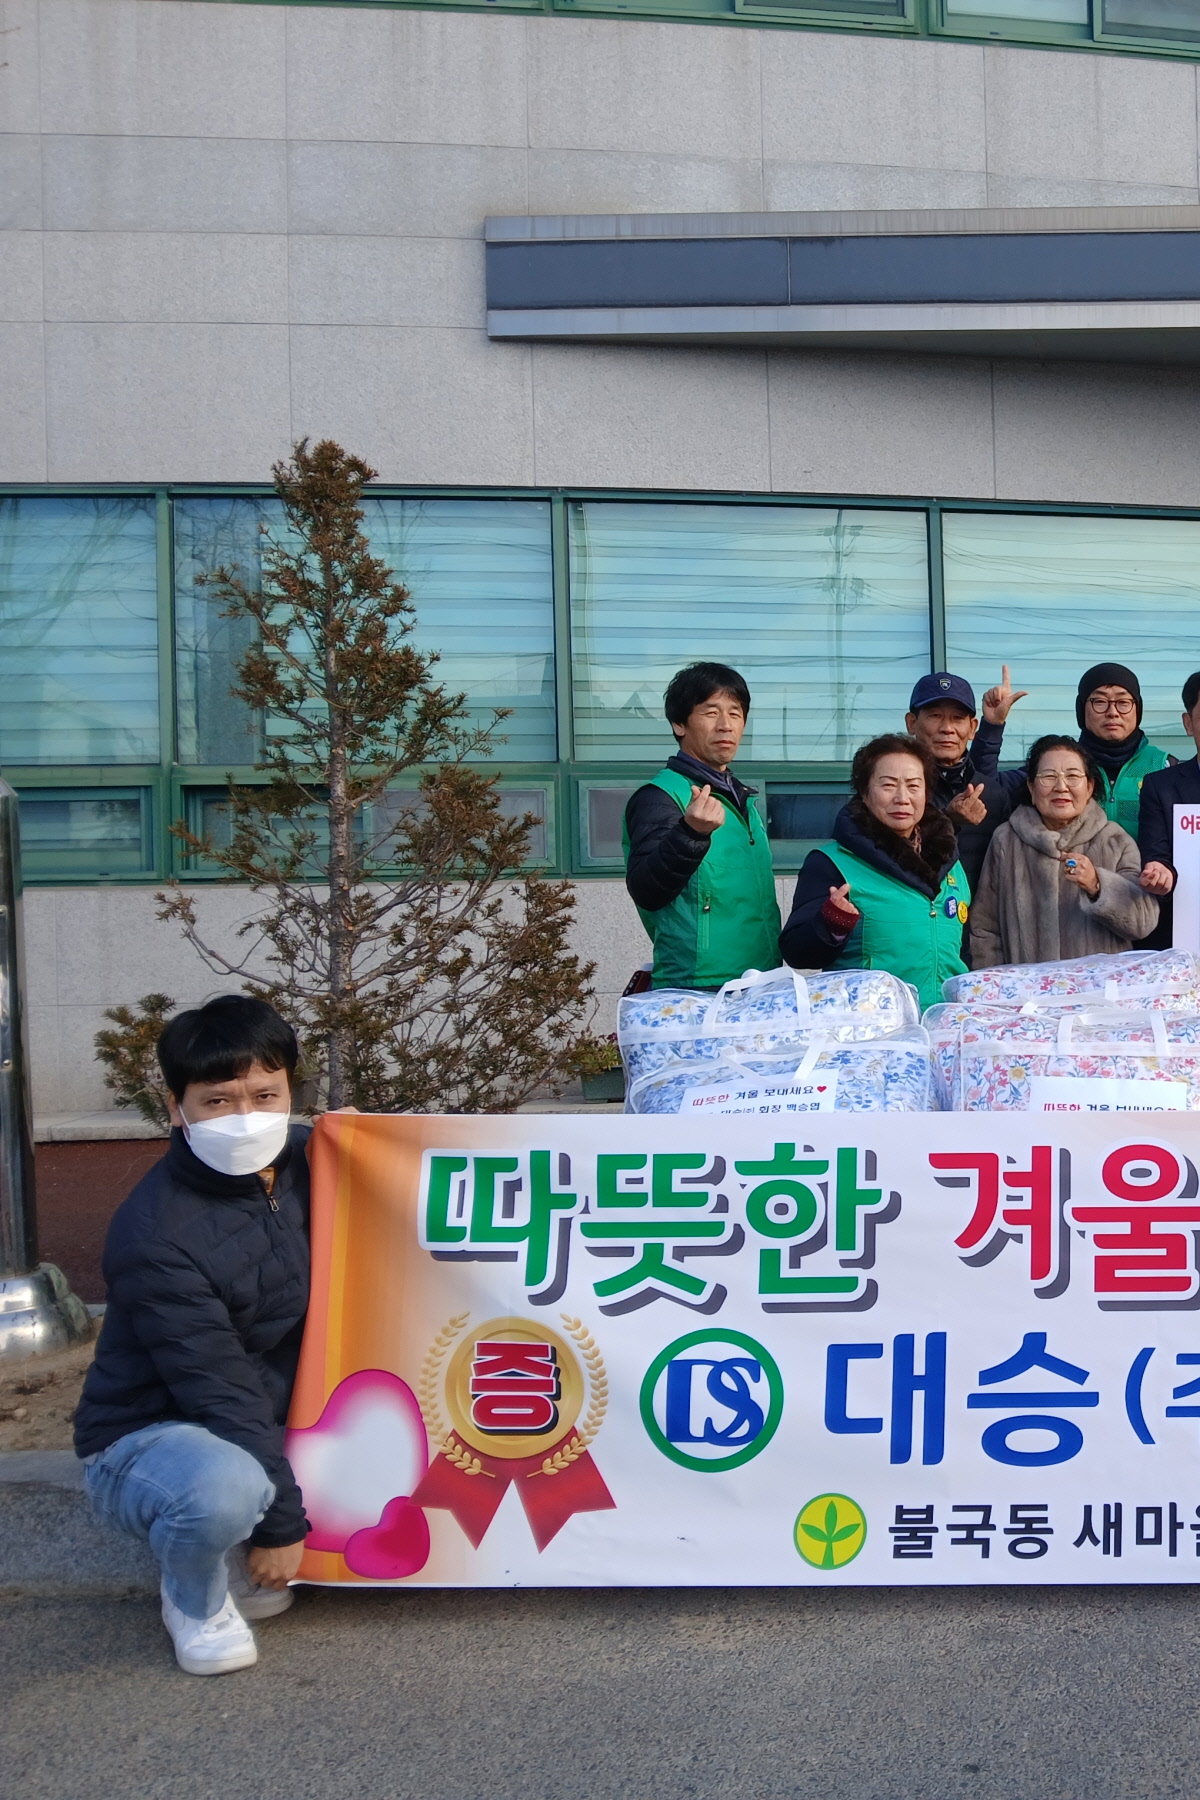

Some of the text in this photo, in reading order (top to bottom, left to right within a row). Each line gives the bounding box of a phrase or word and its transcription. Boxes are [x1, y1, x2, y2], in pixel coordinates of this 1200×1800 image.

[692, 1085, 814, 1107] 따뜻한 겨울 보내세요
[759, 1104, 781, 1114] 회장
[786, 1102, 820, 1112] 백승엽
[424, 1141, 886, 1301] 따뜻한
[470, 1339, 558, 1433] 증
[888, 1502, 1055, 1561] 불국동
